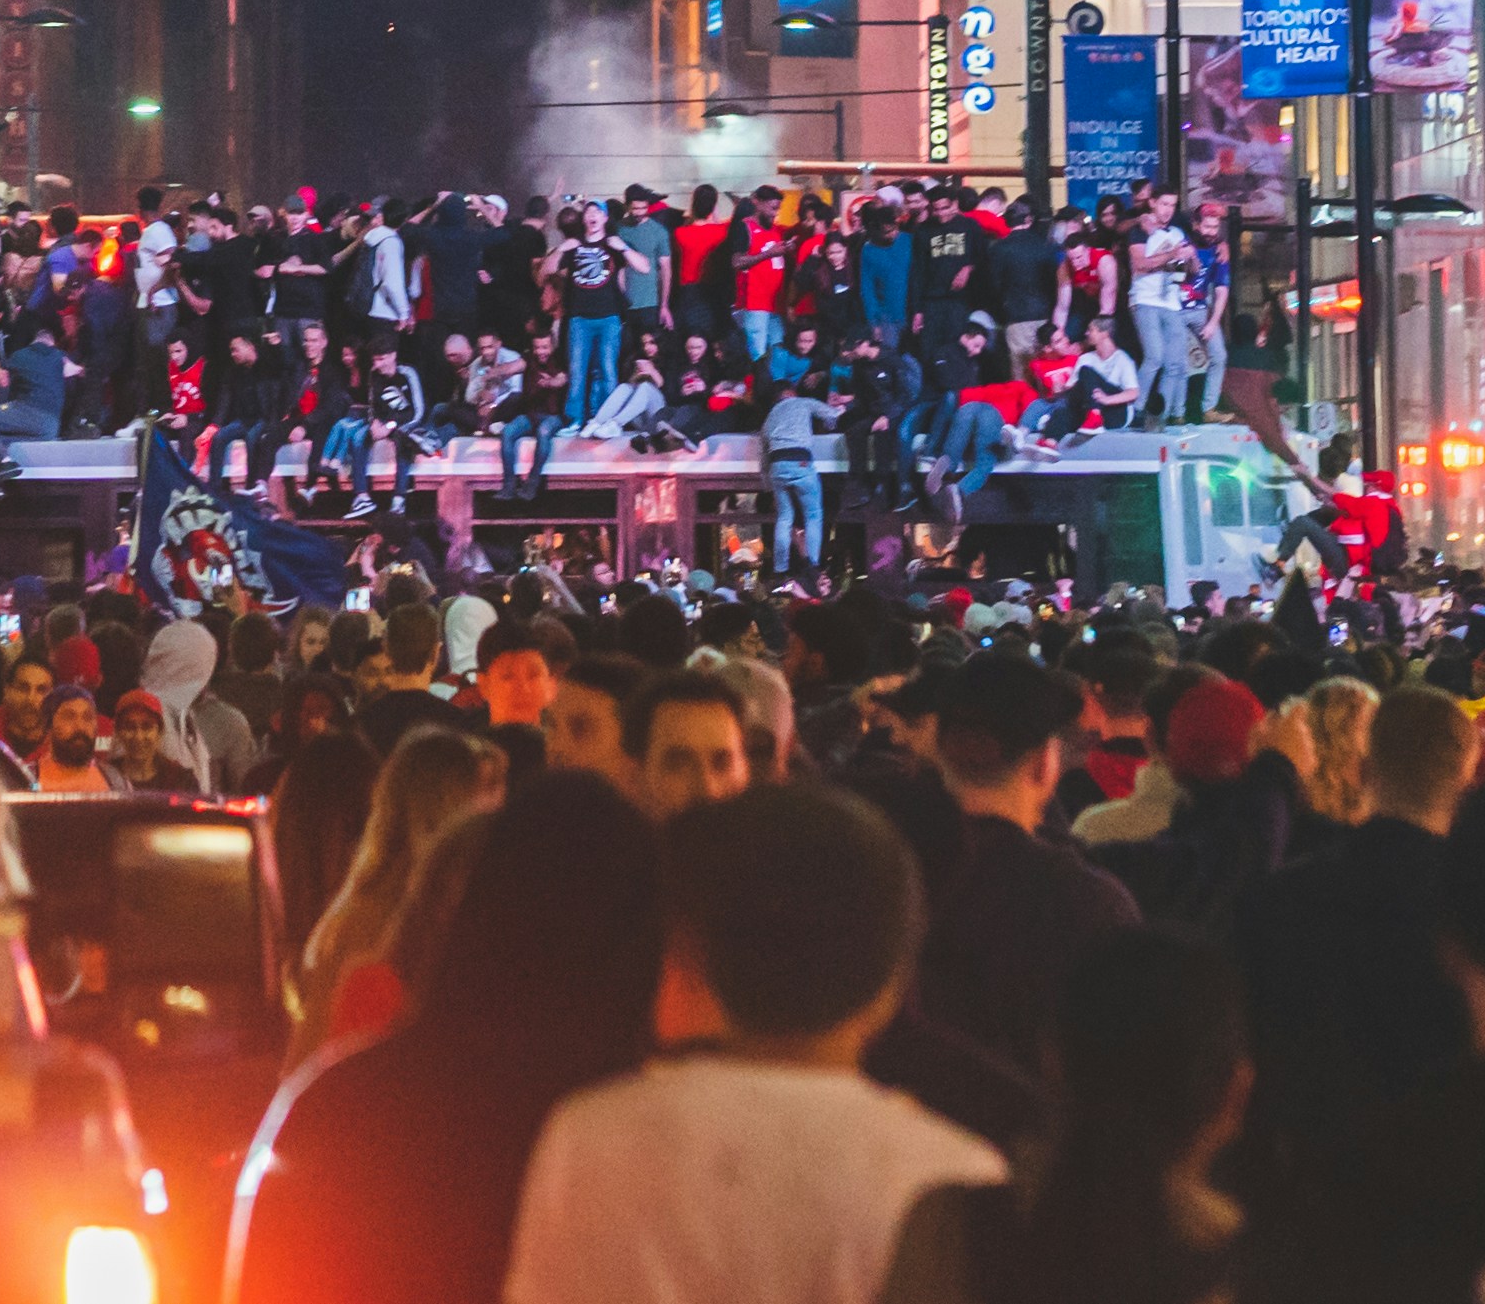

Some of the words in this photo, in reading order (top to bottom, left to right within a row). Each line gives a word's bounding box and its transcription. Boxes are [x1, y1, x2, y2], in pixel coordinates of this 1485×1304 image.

[1243, 7, 1350, 27] TORONTO'S
[1240, 26, 1335, 47] CULTURAL
[1276, 45, 1341, 64] HEART
[931, 27, 948, 159] DOWNTOWN
[1067, 120, 1143, 136] INDULGE
[1101, 135, 1118, 149] IN
[1067, 150, 1161, 165] TORONTO'S
[1063, 165, 1146, 180] CULTURAL
